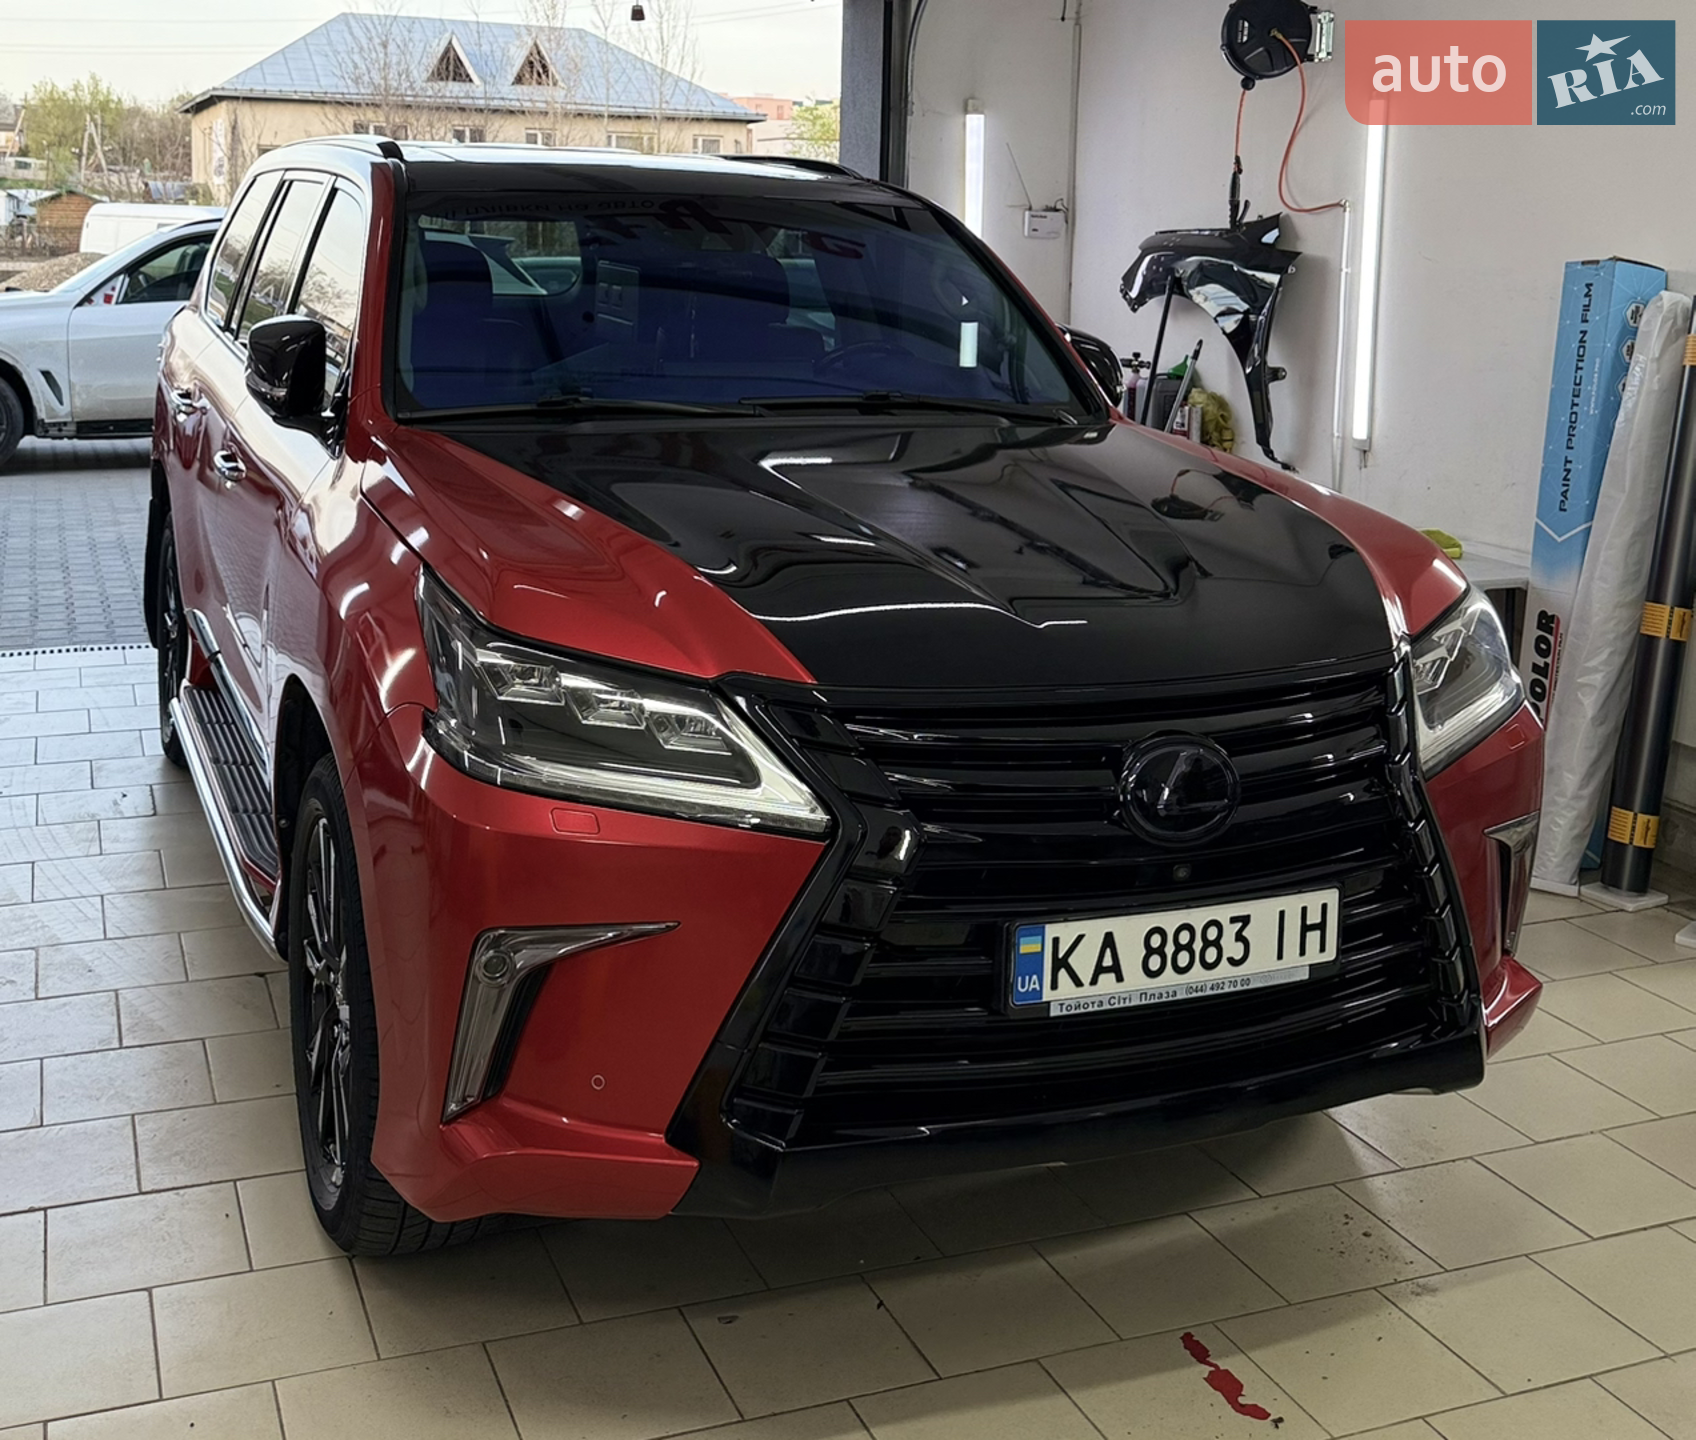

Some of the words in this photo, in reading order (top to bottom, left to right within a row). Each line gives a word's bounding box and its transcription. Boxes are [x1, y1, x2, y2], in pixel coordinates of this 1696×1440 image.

[1558, 455, 1573, 512] PAINT
[1566, 329, 1588, 450] PROTECTION
[1581, 282, 1594, 323] FILM
[1050, 934, 1124, 990] KA
[1141, 914, 1251, 979] 8883
[1276, 902, 1328, 961] IH
[1017, 974, 1040, 992] UA
[1058, 1000, 1104, 1013] Тойота
[1107, 994, 1132, 1007] Сіті
[1139, 989, 1177, 1002] Плаза
[1184, 983, 1207, 996] (044)
[1209, 981, 1225, 991] 492
[1227, 979, 1238, 989] 70
[1240, 977, 1251, 987] 00
